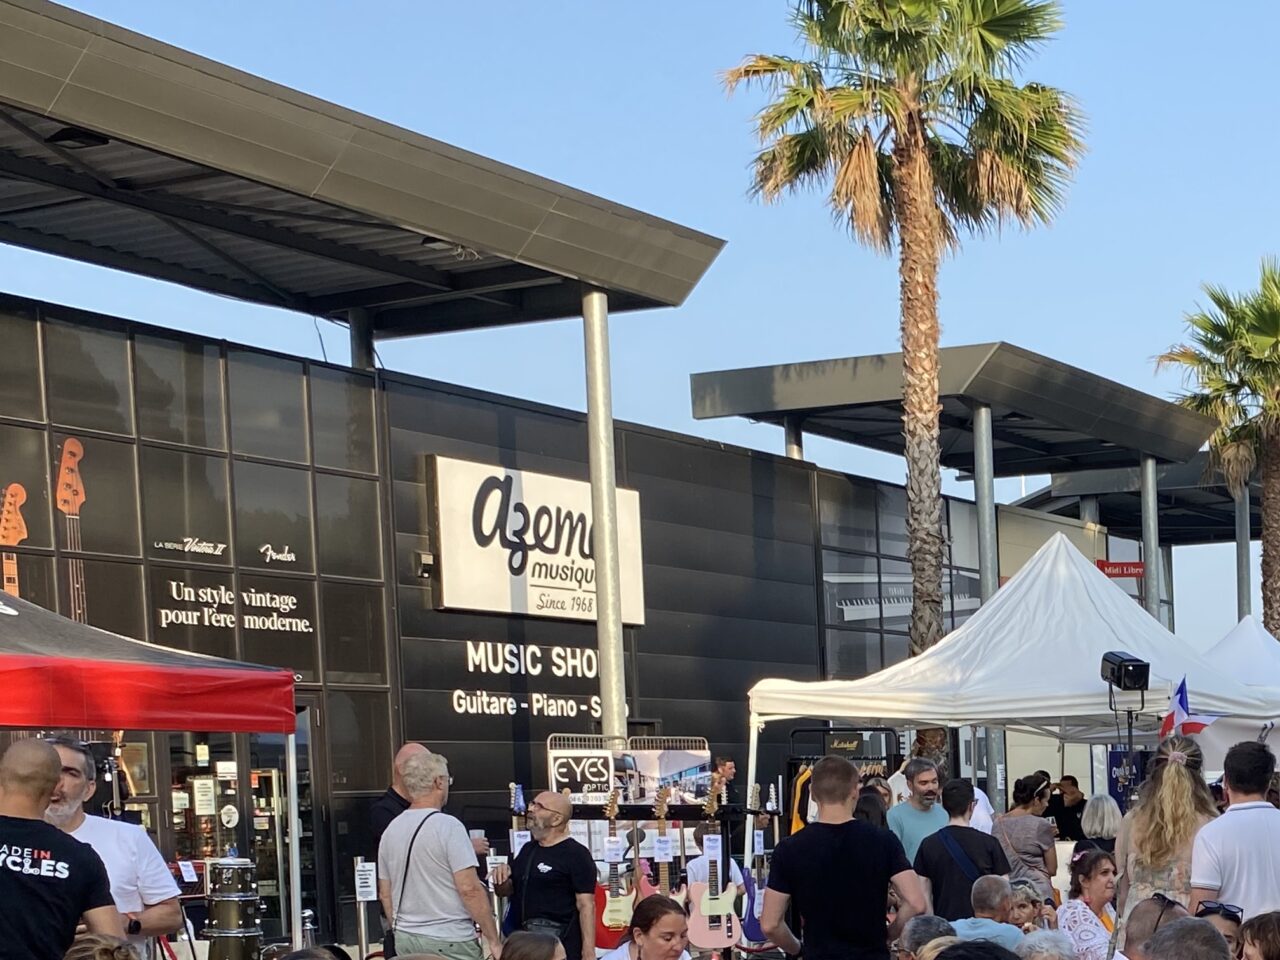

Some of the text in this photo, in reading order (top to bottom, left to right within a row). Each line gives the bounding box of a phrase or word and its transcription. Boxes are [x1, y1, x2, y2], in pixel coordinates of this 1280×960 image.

[260, 544, 296, 563] Fender
[531, 560, 597, 589] musiqu
[1104, 566, 1144, 574] Midi Libre
[170, 581, 298, 613] Un style vintage
[536, 593, 593, 613] Since 1968
[160, 608, 200, 628] pour
[243, 612, 314, 633] moderne.
[466, 640, 600, 679] MUSIC SHO
[452, 689, 517, 715] Guitare
[531, 693, 577, 718] Piano
[554, 758, 609, 782] EYES
